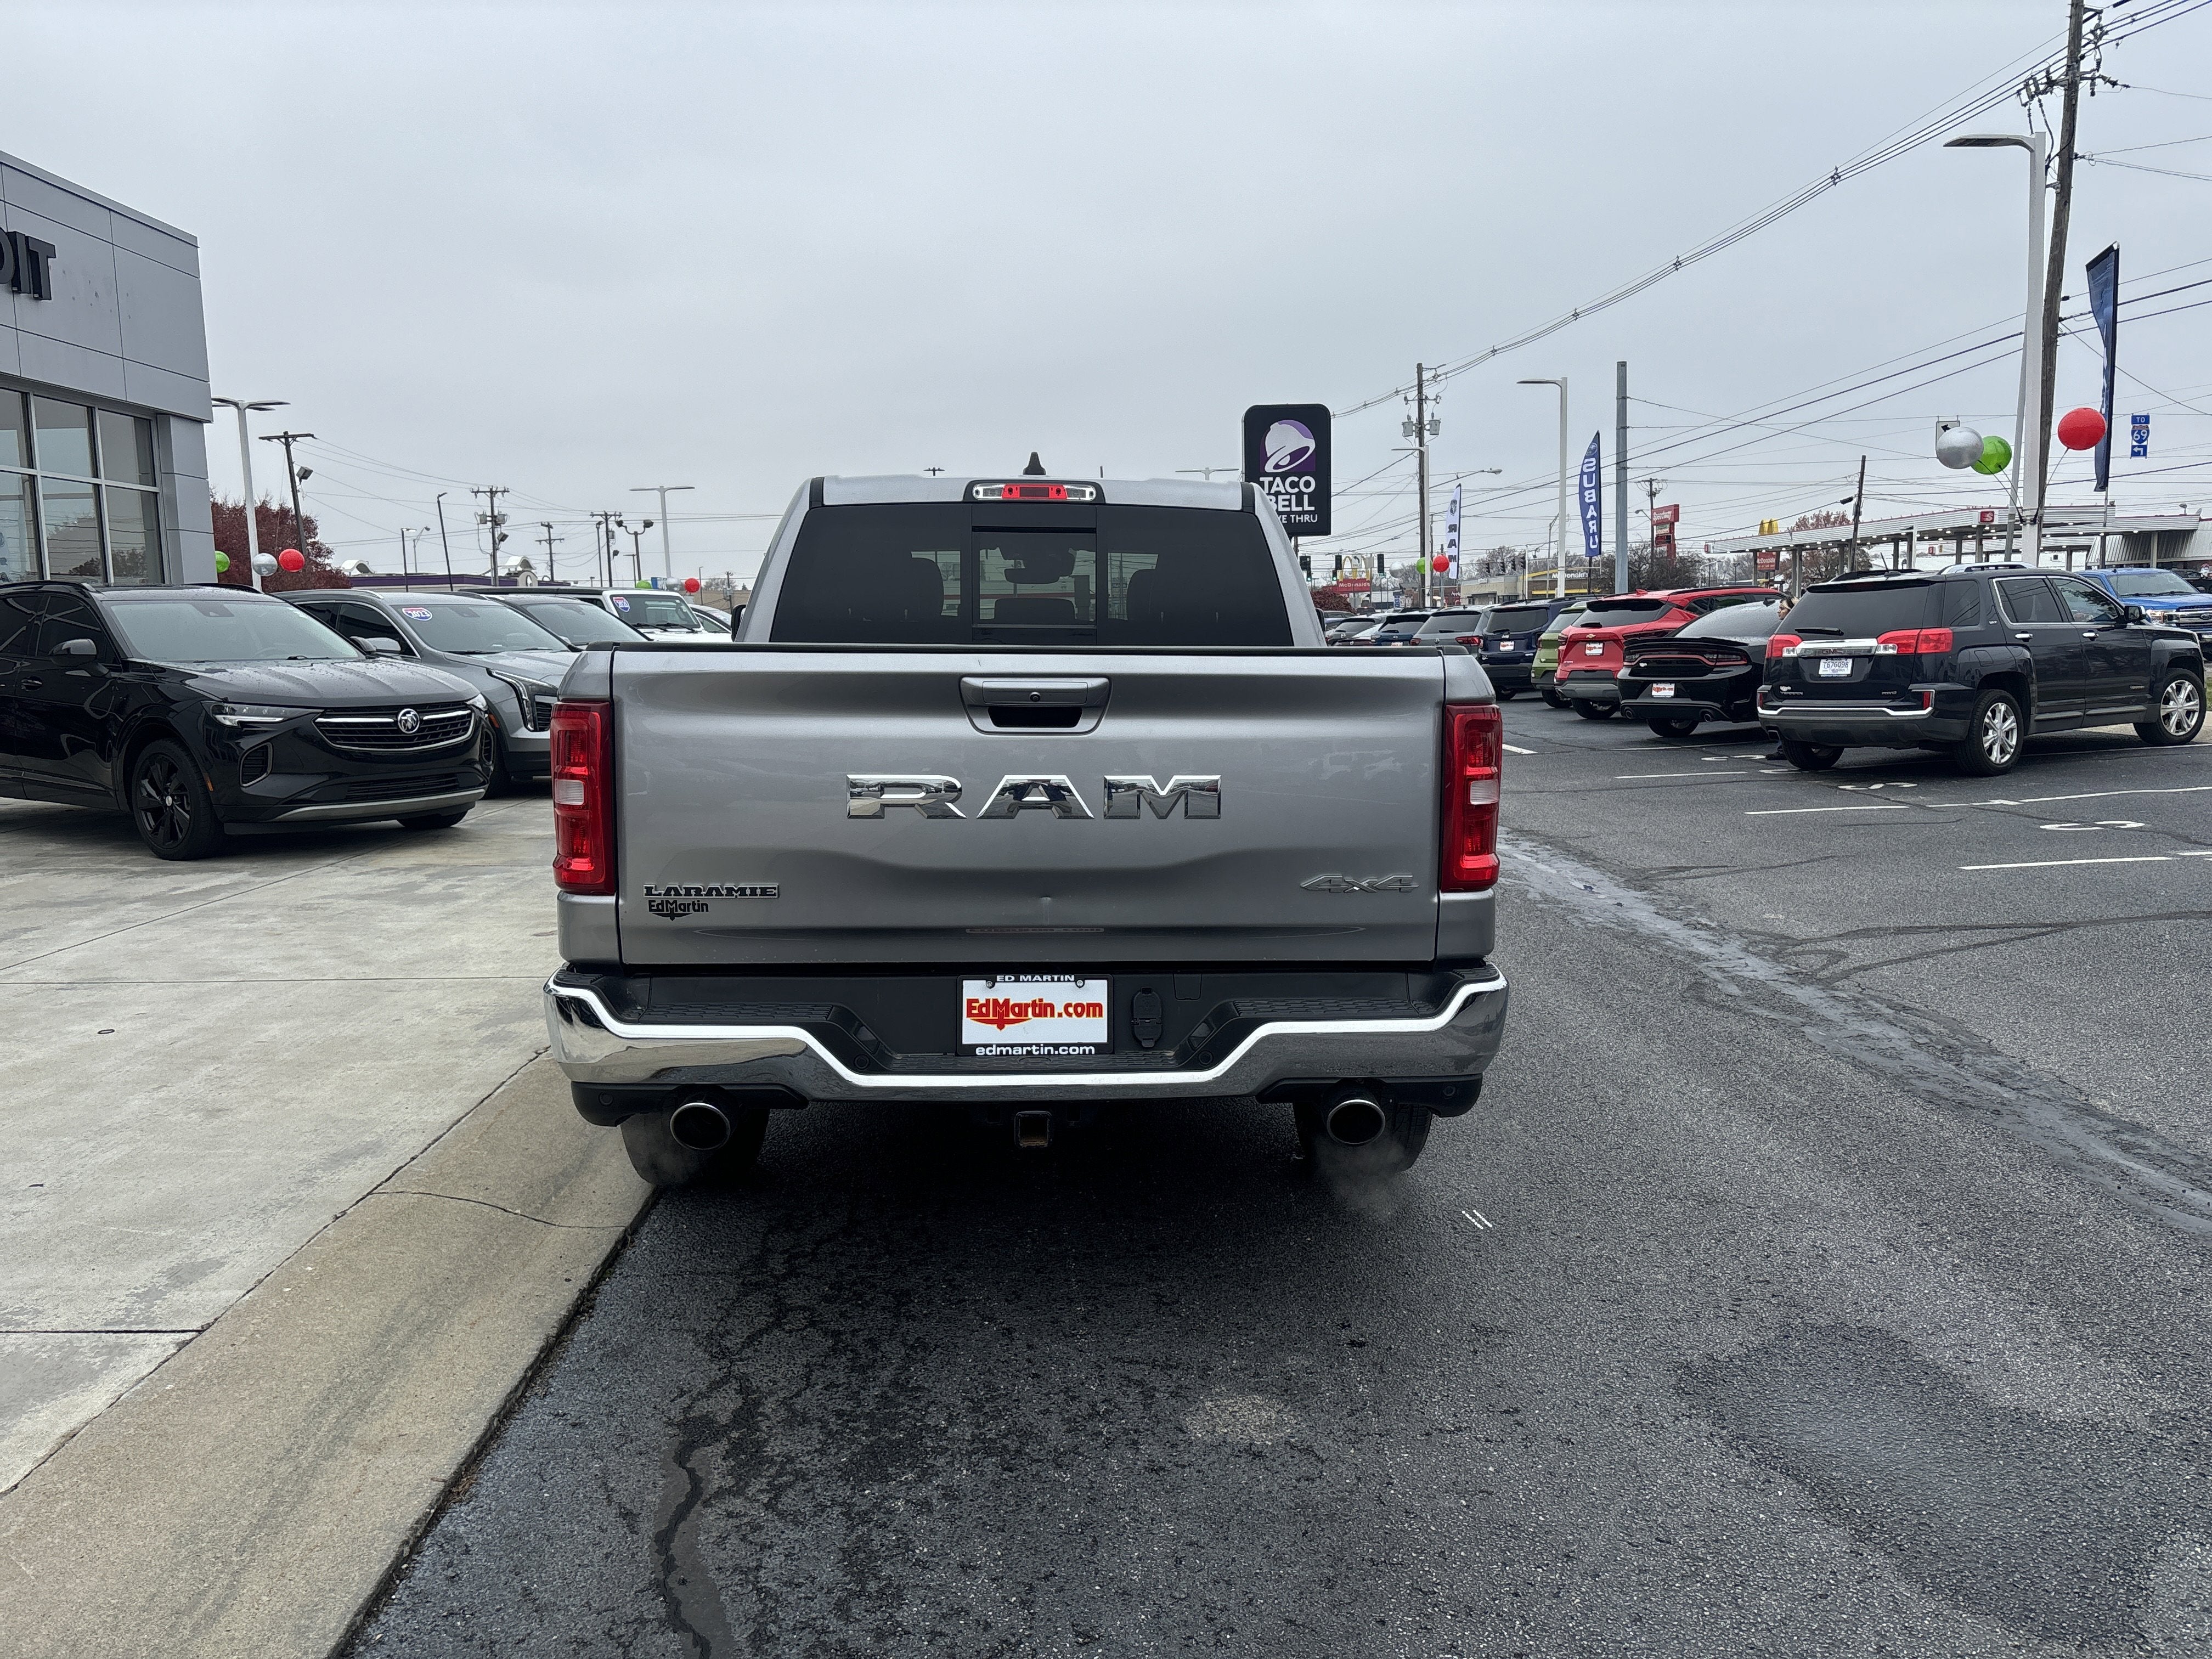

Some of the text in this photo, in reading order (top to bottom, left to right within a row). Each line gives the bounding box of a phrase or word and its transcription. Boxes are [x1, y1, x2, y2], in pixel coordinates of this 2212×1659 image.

[2133, 430, 2148, 441] 69
[1259, 476, 1316, 493] TACO
[1289, 514, 1318, 523] THRU
[845, 774, 1222, 820] RAM
[644, 884, 779, 898] LARAMIE
[1301, 875, 1419, 893] 4x4
[966, 998, 1104, 1019] EdMartin.com
[975, 1043, 1095, 1055] edmartin.com
